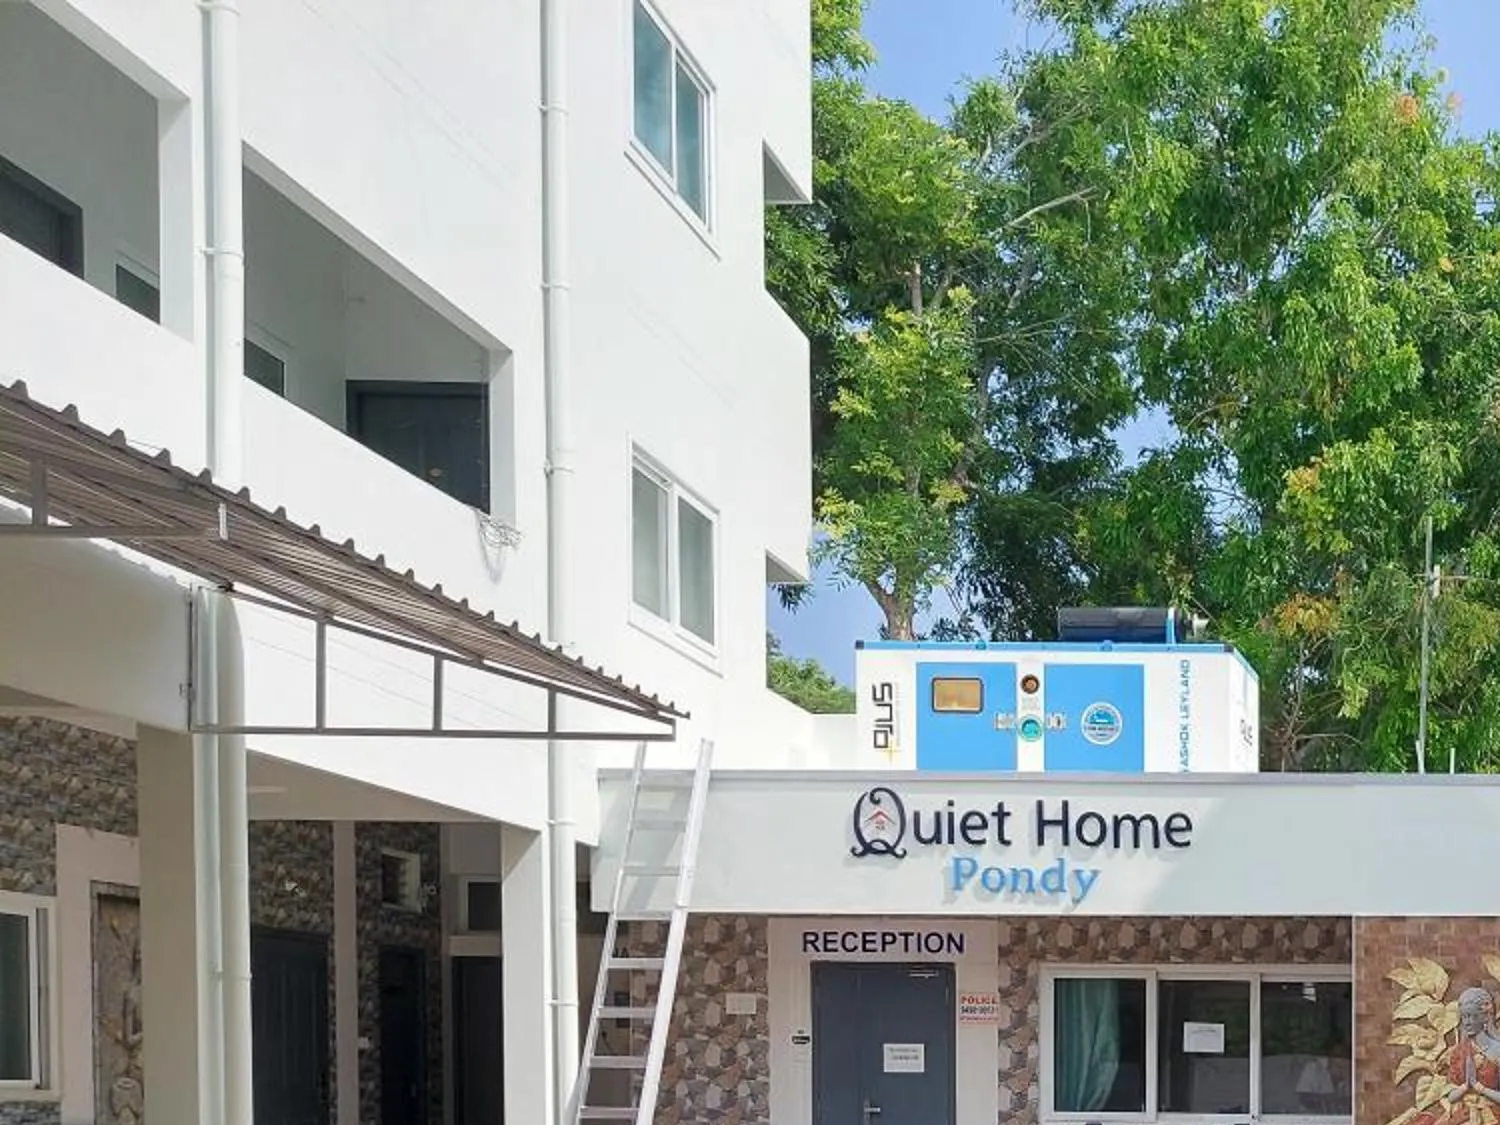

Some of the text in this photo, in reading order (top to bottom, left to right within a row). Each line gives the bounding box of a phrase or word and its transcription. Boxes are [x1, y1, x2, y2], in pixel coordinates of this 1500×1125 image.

[1180, 659, 1189, 767] ASHOK LEYLAND
[851, 787, 1192, 859] Quiet Home
[952, 857, 1101, 904] Pondy
[803, 931, 964, 953] RECEPTION
